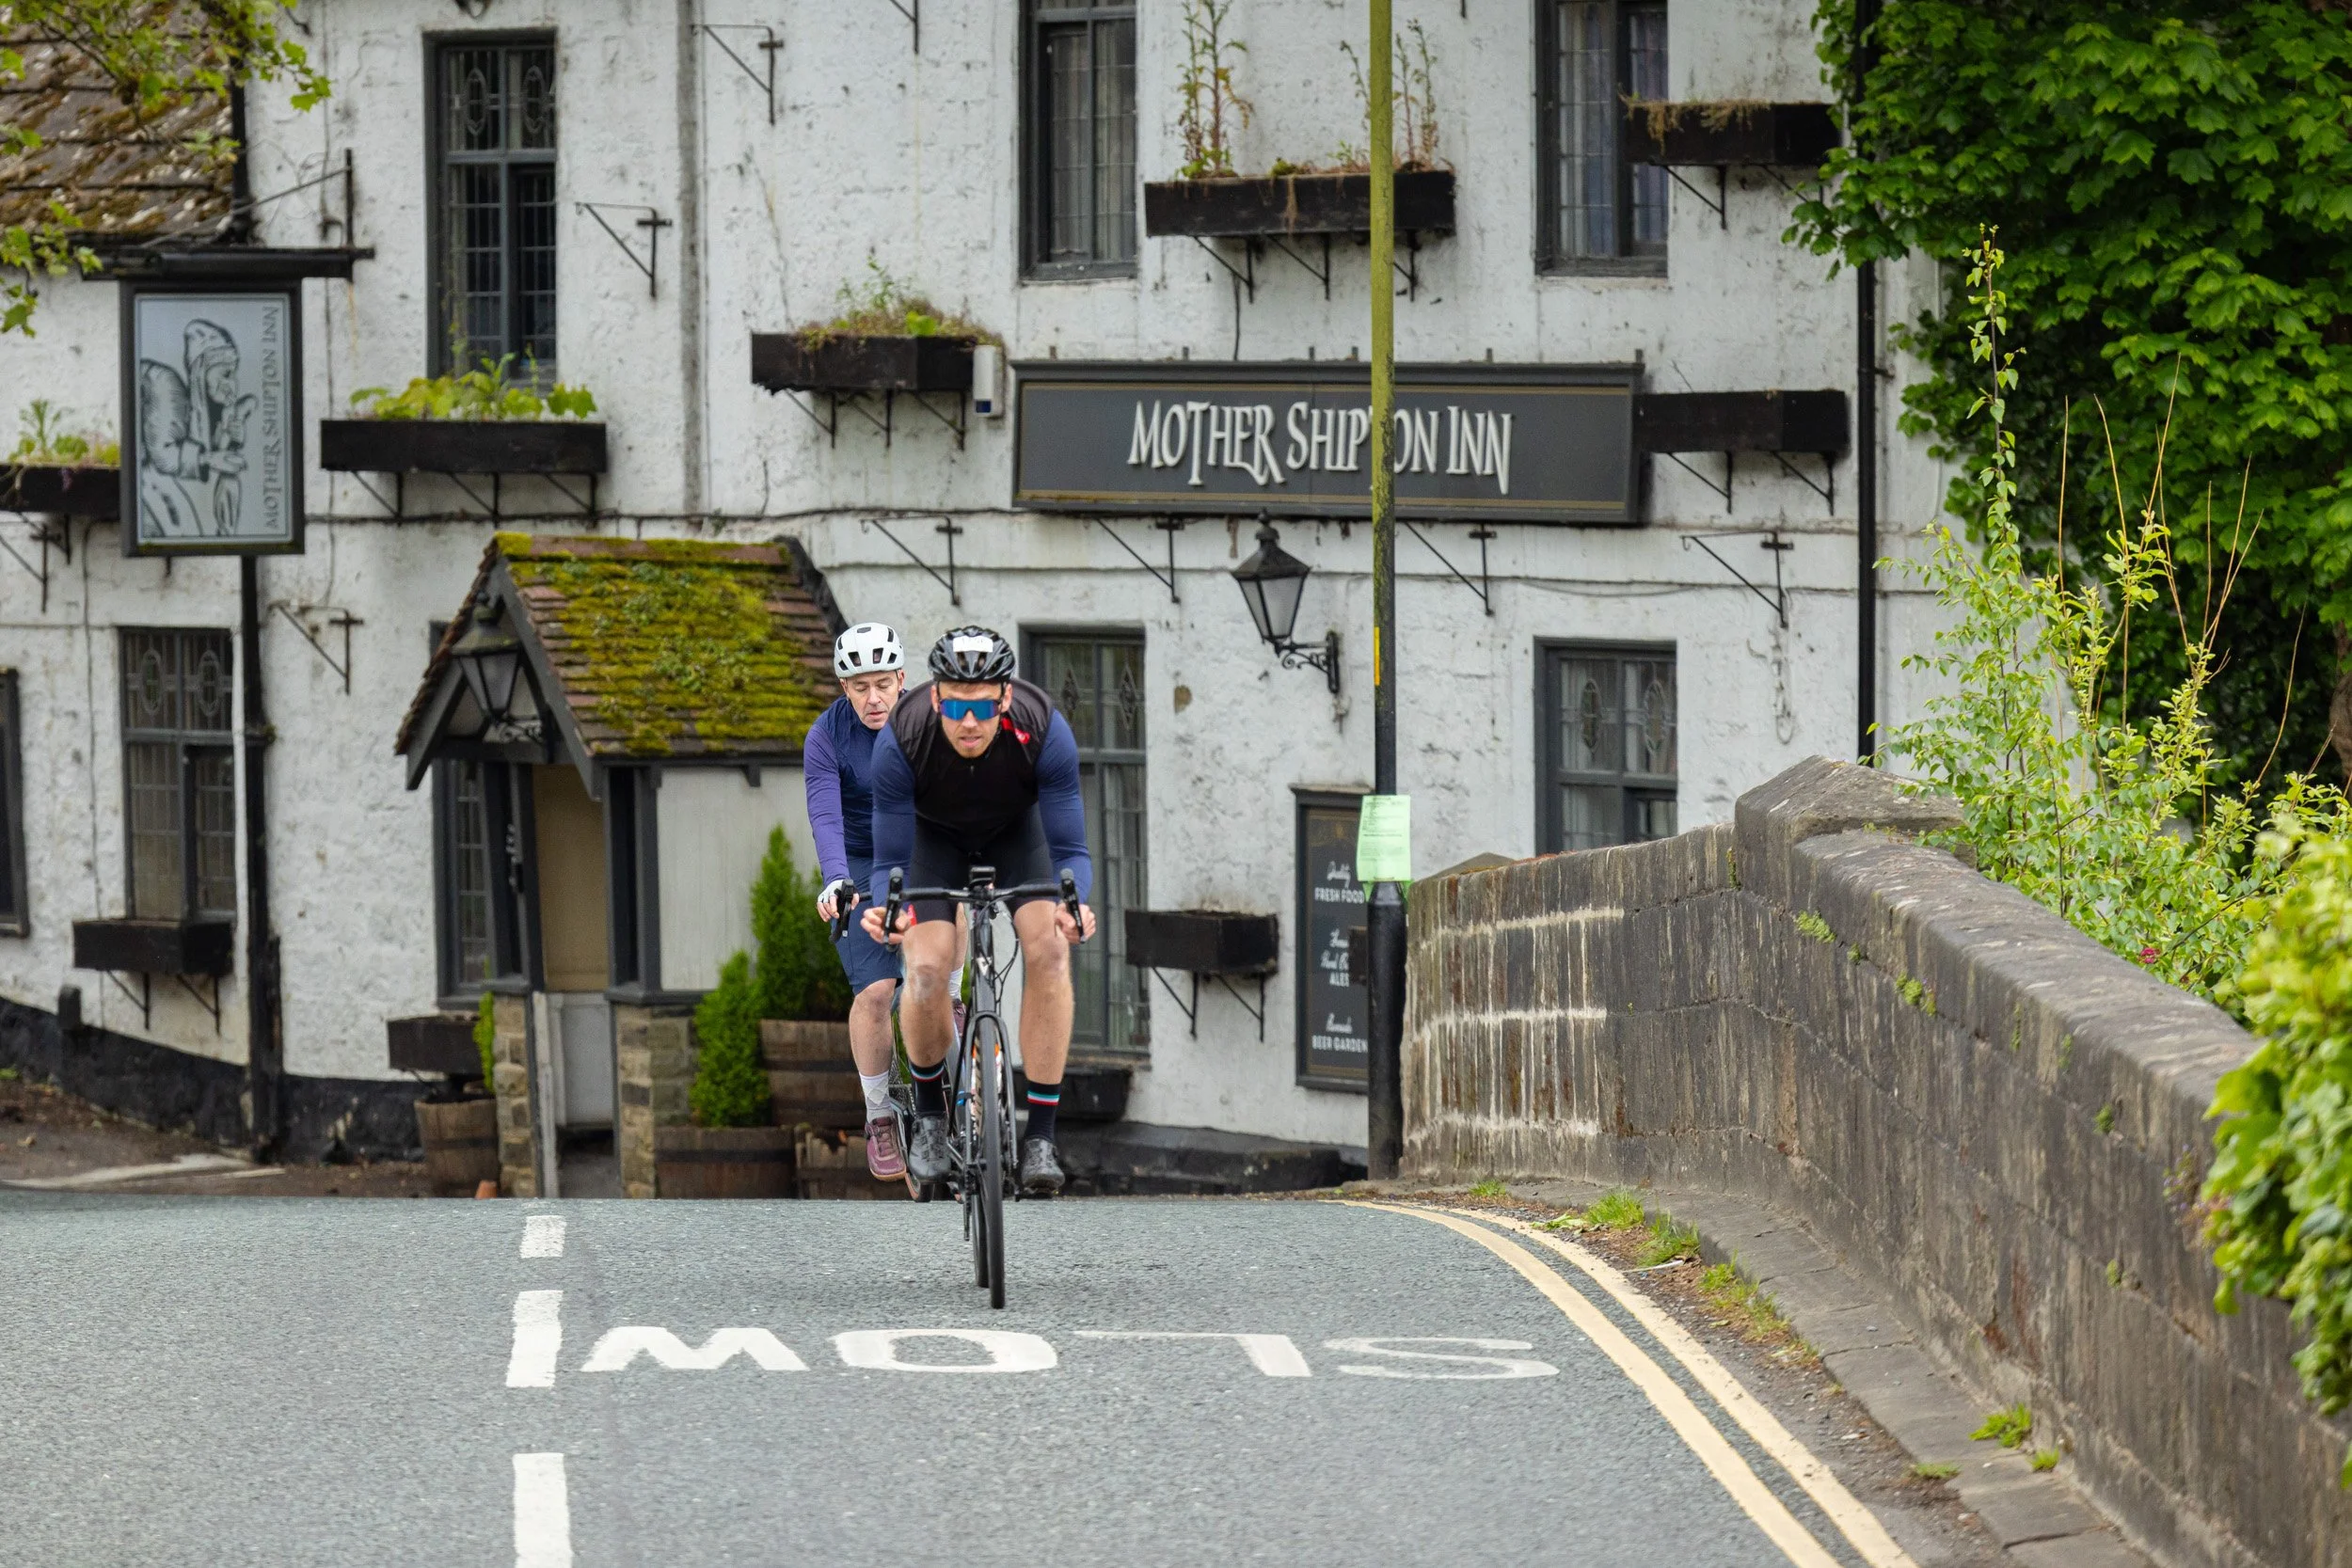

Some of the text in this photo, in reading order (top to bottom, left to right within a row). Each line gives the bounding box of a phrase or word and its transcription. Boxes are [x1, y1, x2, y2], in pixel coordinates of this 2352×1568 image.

[262, 306, 281, 529] MOTHER SHIPTON INN
[1127, 400, 1512, 495] MOTHER SHIPON INN
[1314, 887, 1365, 904] FRESH FOOD
[1329, 972, 1349, 987] ALES
[1311, 1035, 1368, 1053] BEER GARDEN
[580, 1323, 1560, 1379] SLOW
